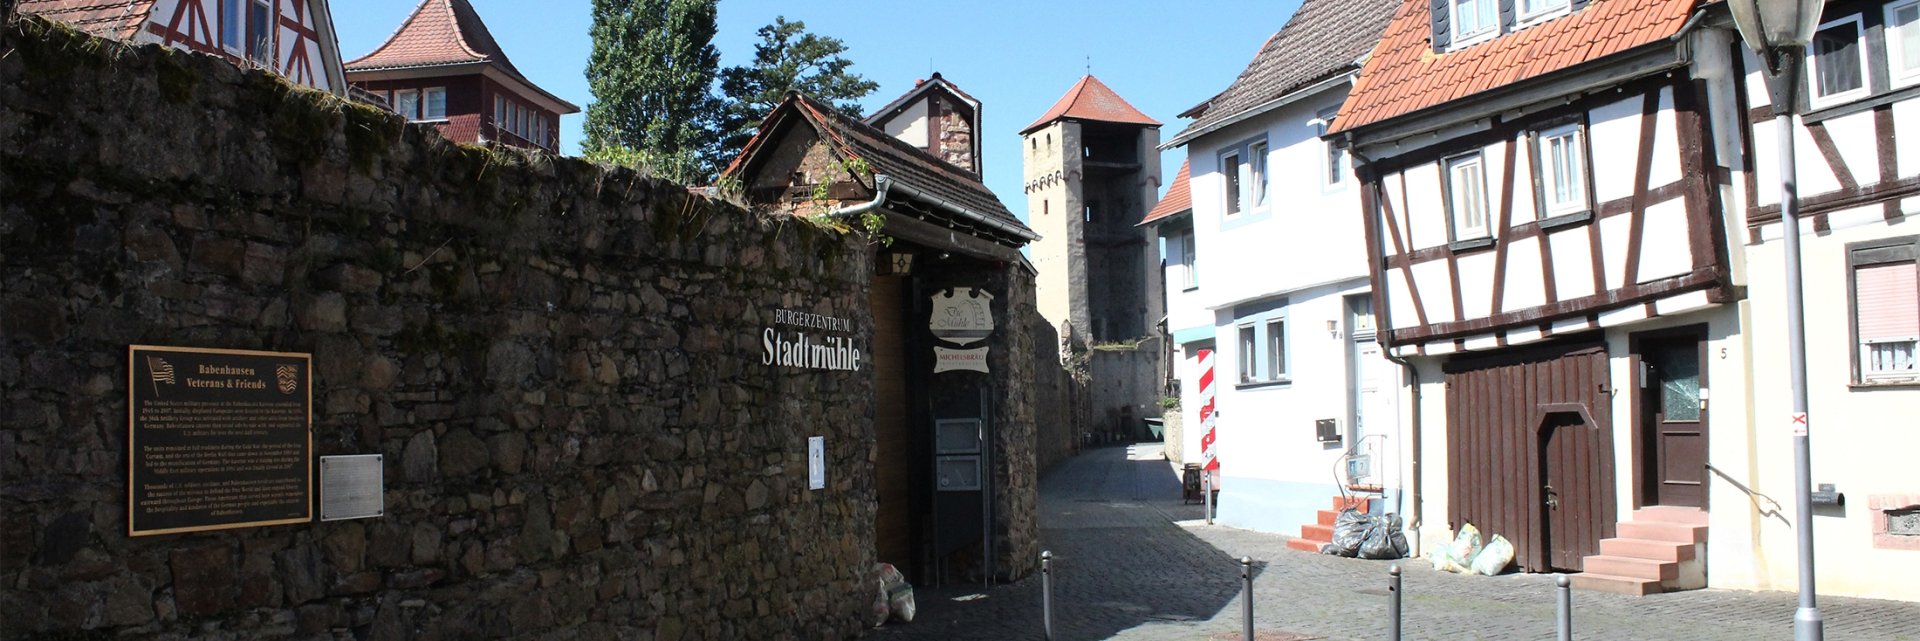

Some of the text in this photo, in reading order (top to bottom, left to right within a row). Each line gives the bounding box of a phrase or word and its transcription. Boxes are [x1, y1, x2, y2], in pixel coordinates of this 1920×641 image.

[762, 327, 860, 371] Stadtmühle
[1721, 348, 1727, 359] 5
[199, 364, 255, 375] Babenhausen
[186, 378, 266, 388] Veterans & Friends
